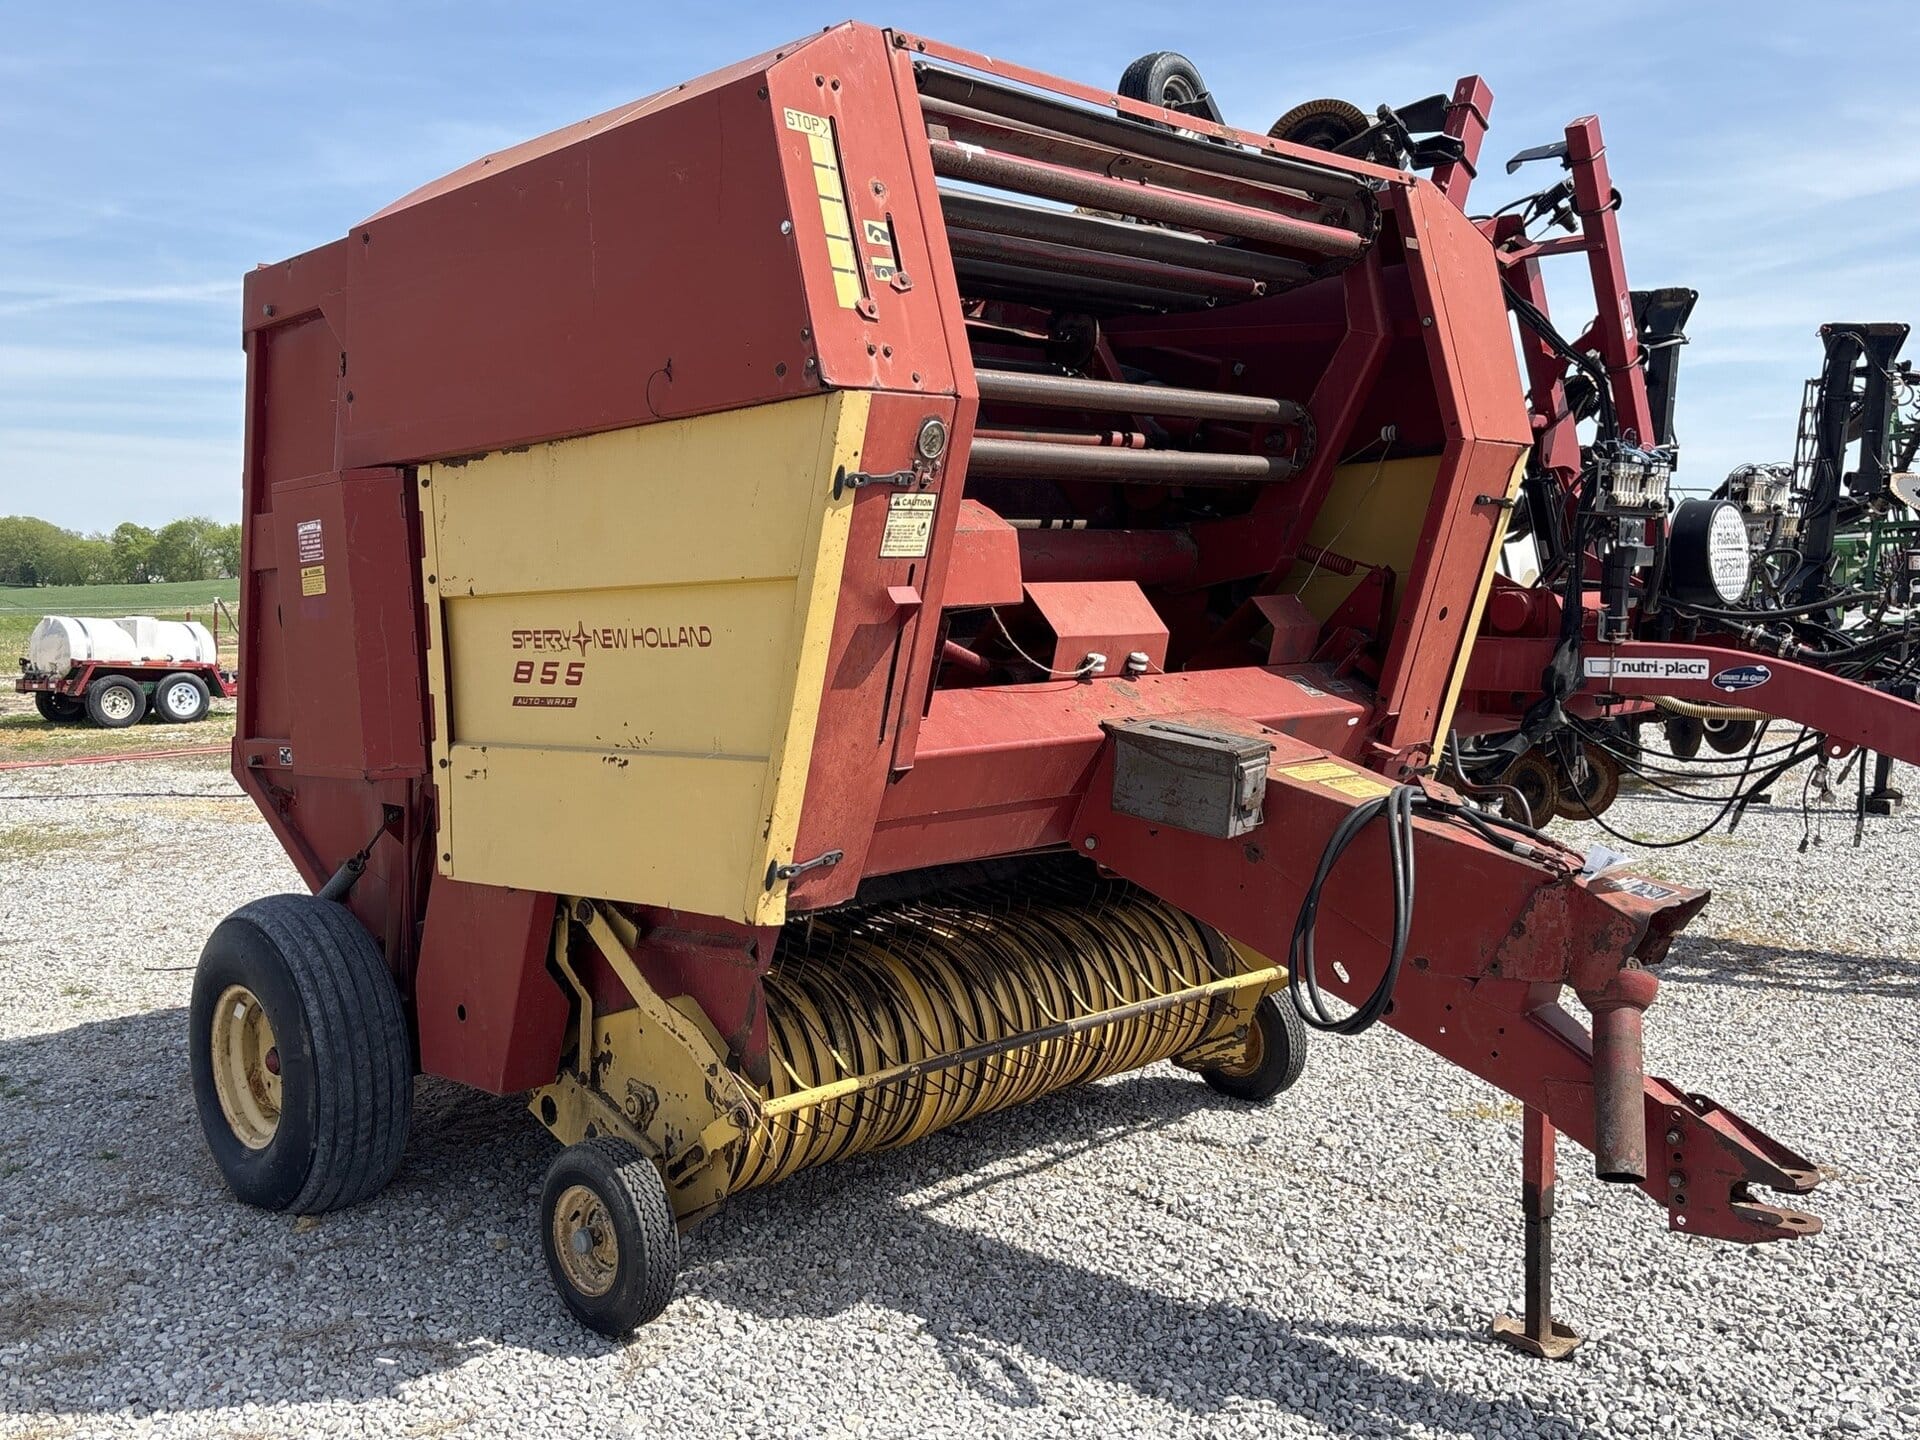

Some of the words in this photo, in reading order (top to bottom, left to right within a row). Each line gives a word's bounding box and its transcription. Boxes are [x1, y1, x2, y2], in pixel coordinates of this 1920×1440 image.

[786, 111, 819, 131] STOP
[902, 498, 932, 506] CAUTION
[512, 630, 571, 648] SPERRY
[592, 628, 628, 648] NEW
[632, 626, 712, 648] HOLLAND
[513, 660, 586, 686] 855
[1622, 660, 1706, 676] nutri-placr
